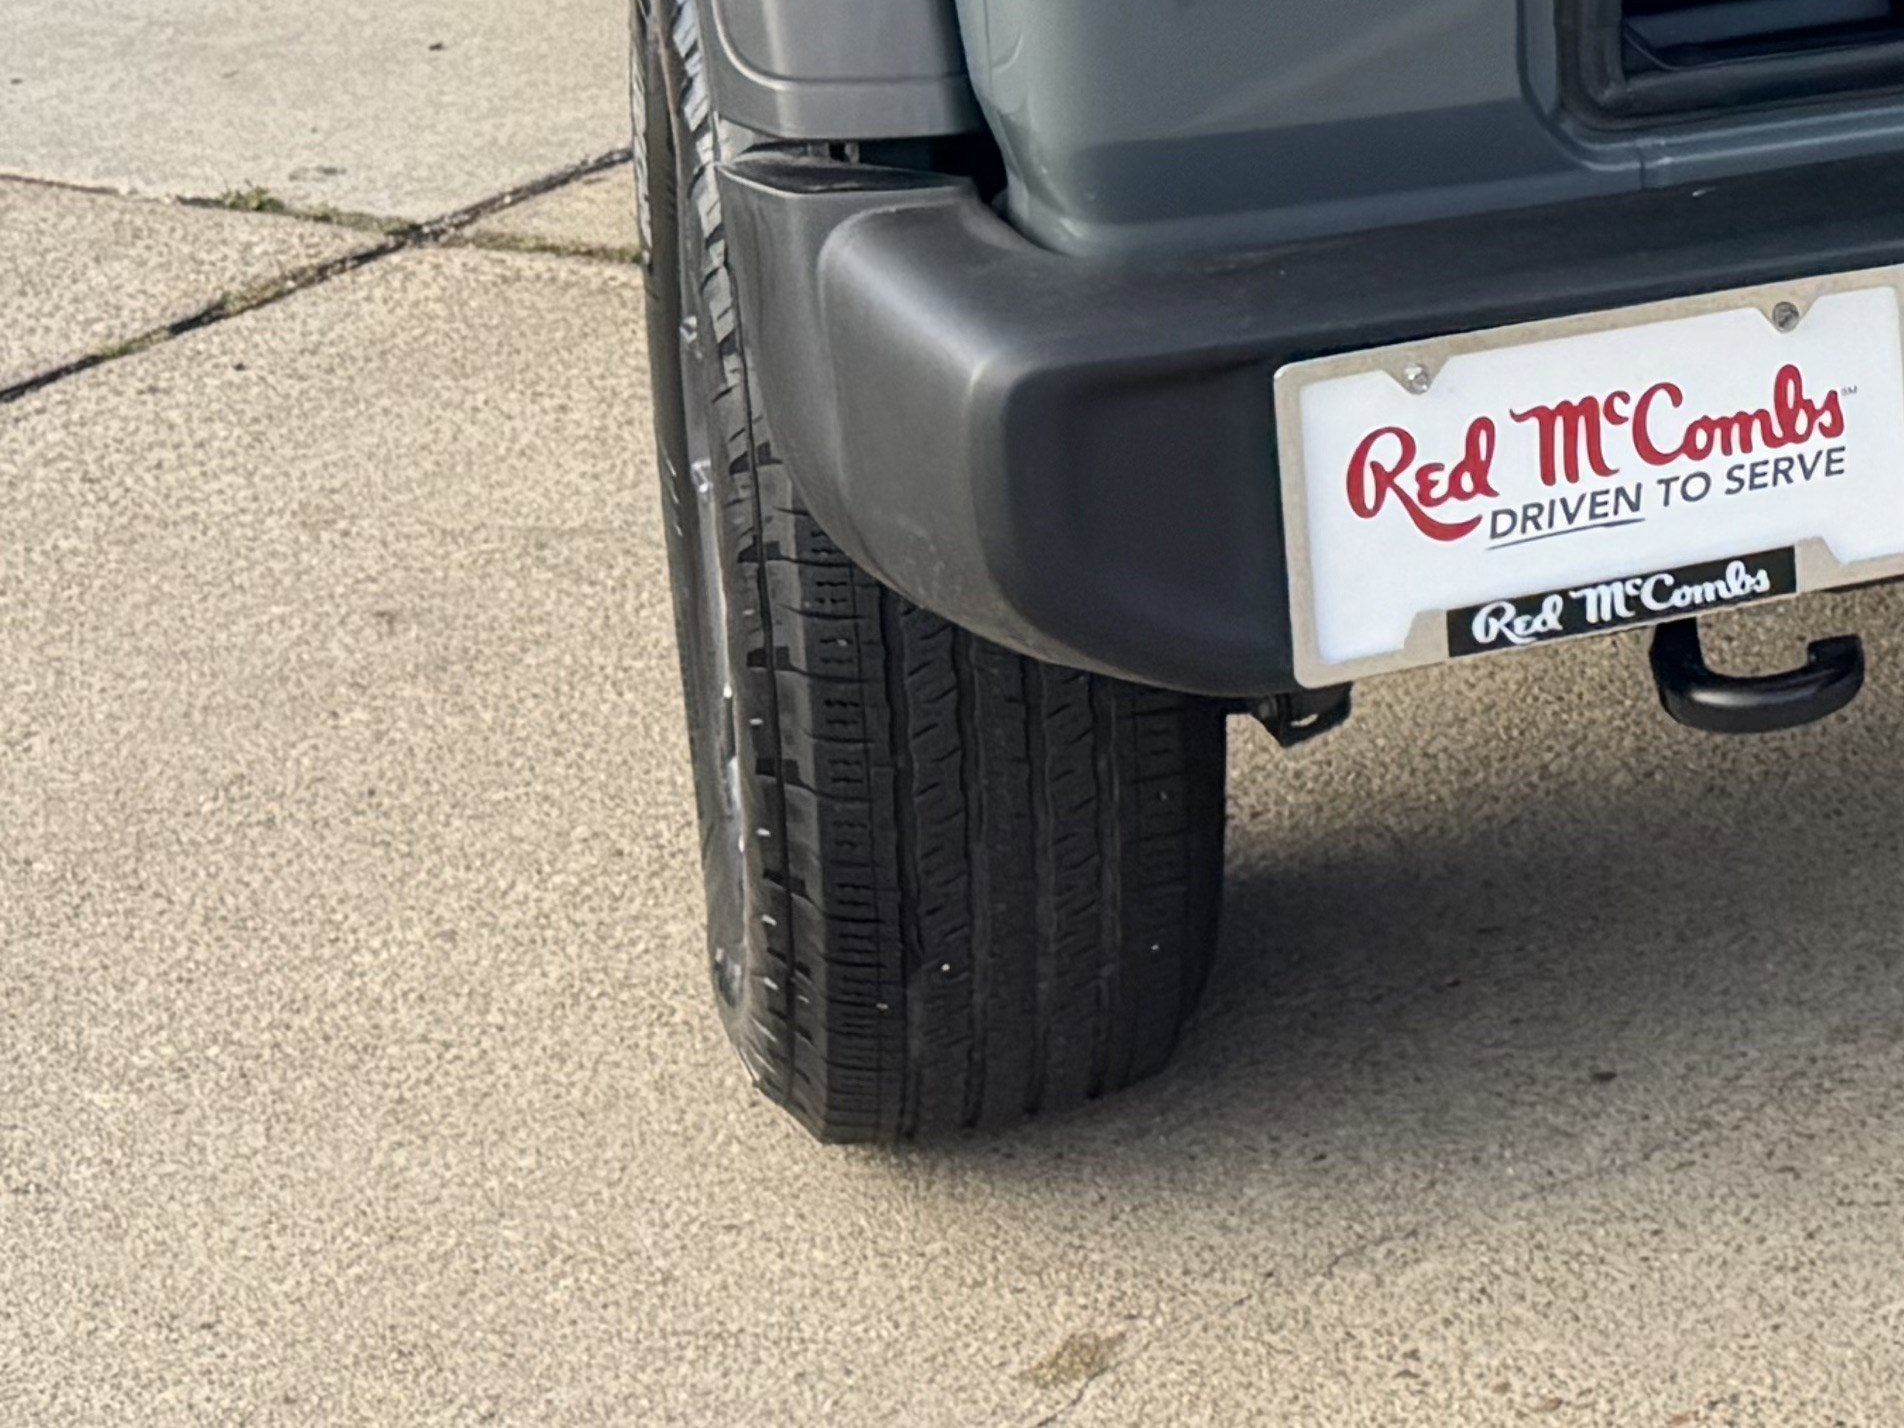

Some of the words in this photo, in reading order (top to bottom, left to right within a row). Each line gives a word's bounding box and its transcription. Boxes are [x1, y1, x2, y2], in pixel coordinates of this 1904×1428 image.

[1346, 416, 1500, 542] Red
[1509, 363, 1846, 485] McCombs
[1489, 483, 1643, 540] DRIVEN
[1659, 471, 1712, 508] TO
[1724, 446, 1846, 496] SERVE
[1472, 594, 1563, 644] Red
[1569, 560, 1771, 624] McCombs
